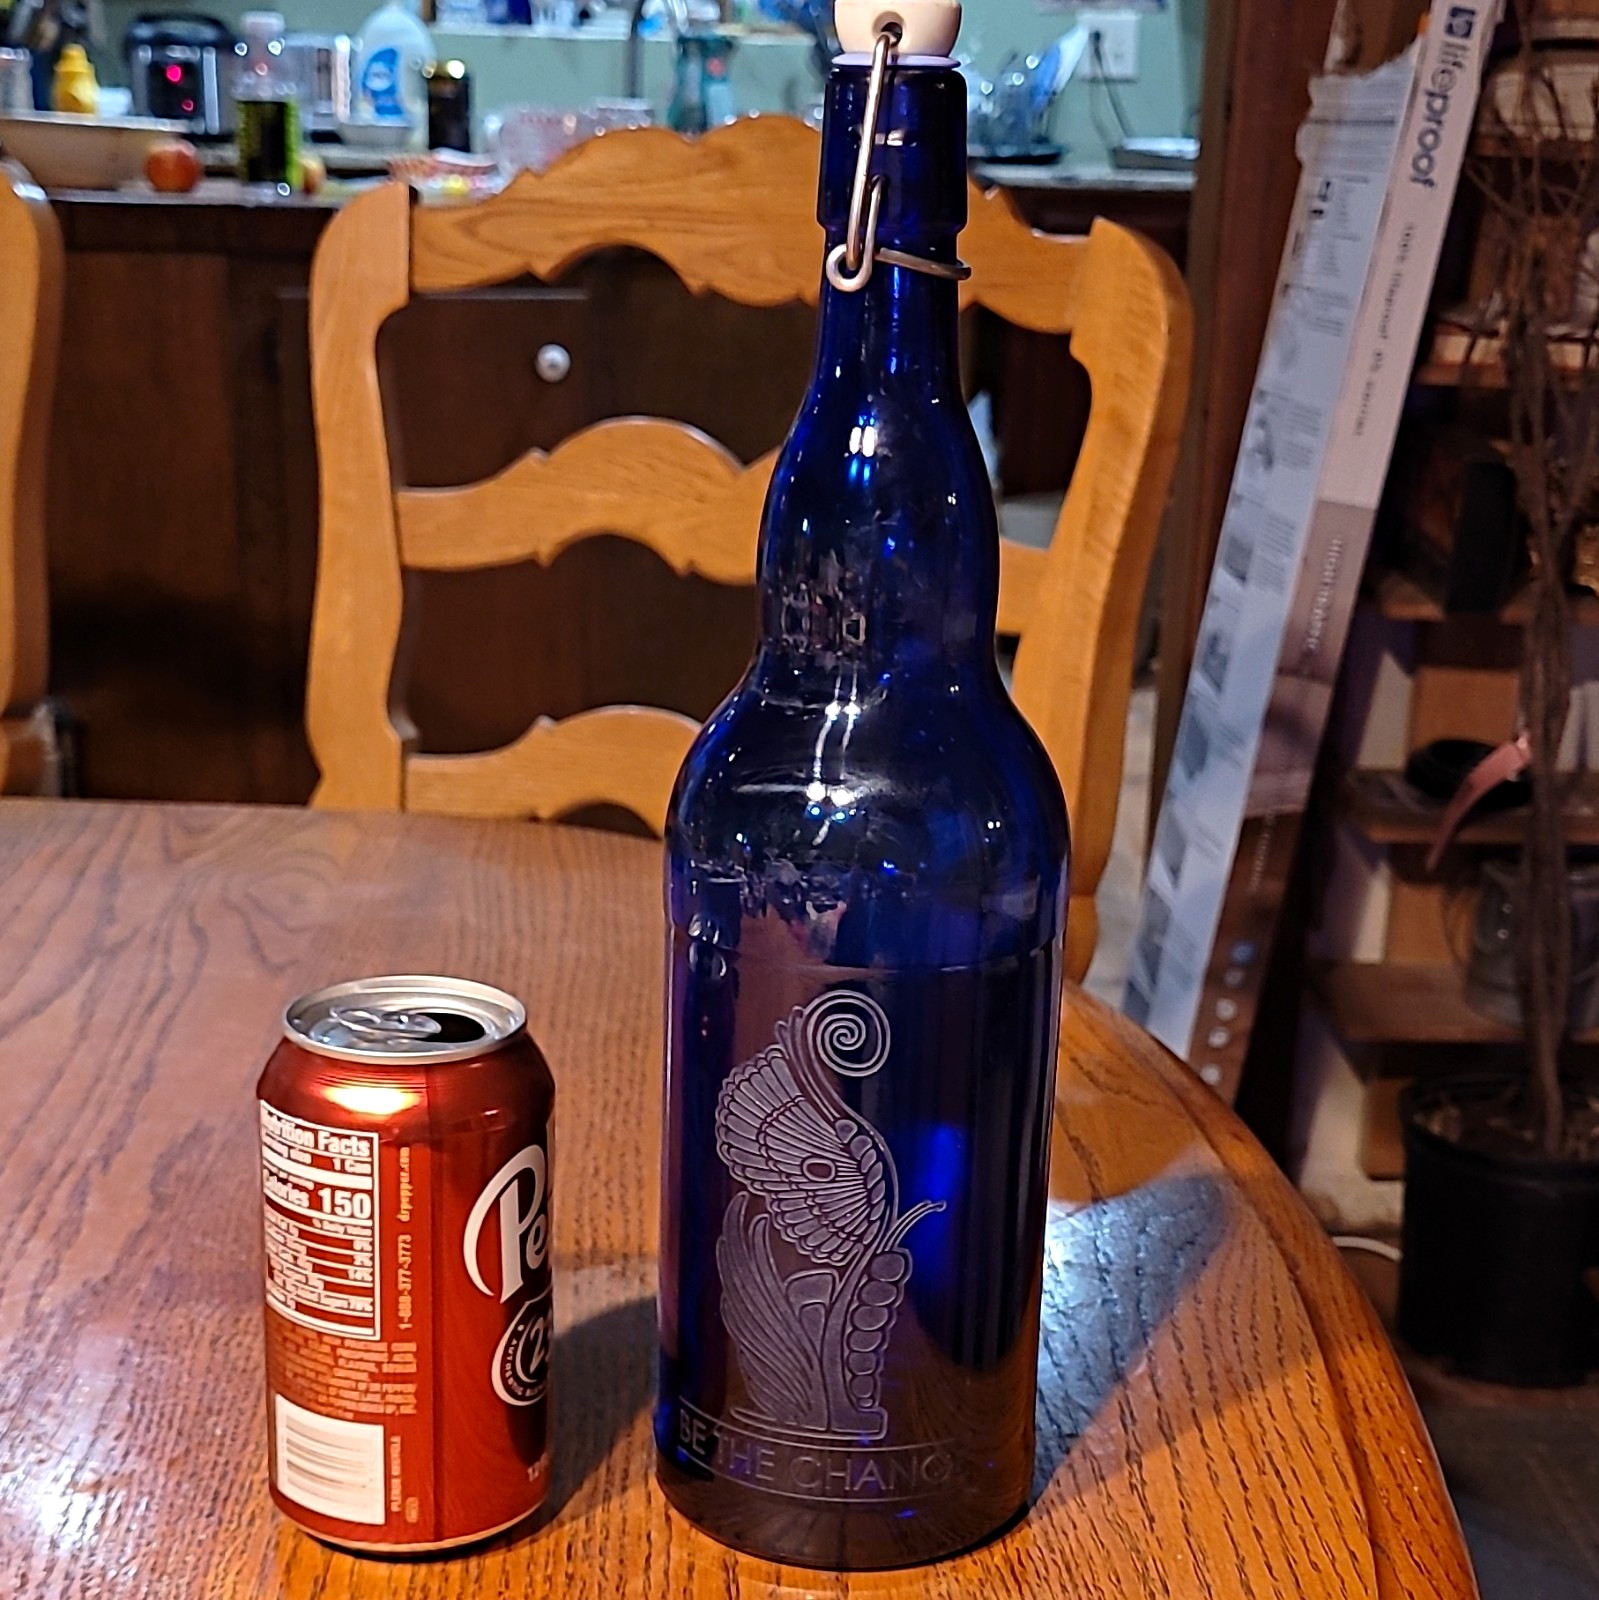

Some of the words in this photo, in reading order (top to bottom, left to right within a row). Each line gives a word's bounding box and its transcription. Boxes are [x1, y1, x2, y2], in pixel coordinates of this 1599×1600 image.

[1410, 41, 1469, 189] lifeproof
[317, 1131, 371, 1158] Facts
[317, 1187, 371, 1219] 150
[680, 1408, 707, 1455] BE
[712, 1430, 775, 1481] THE
